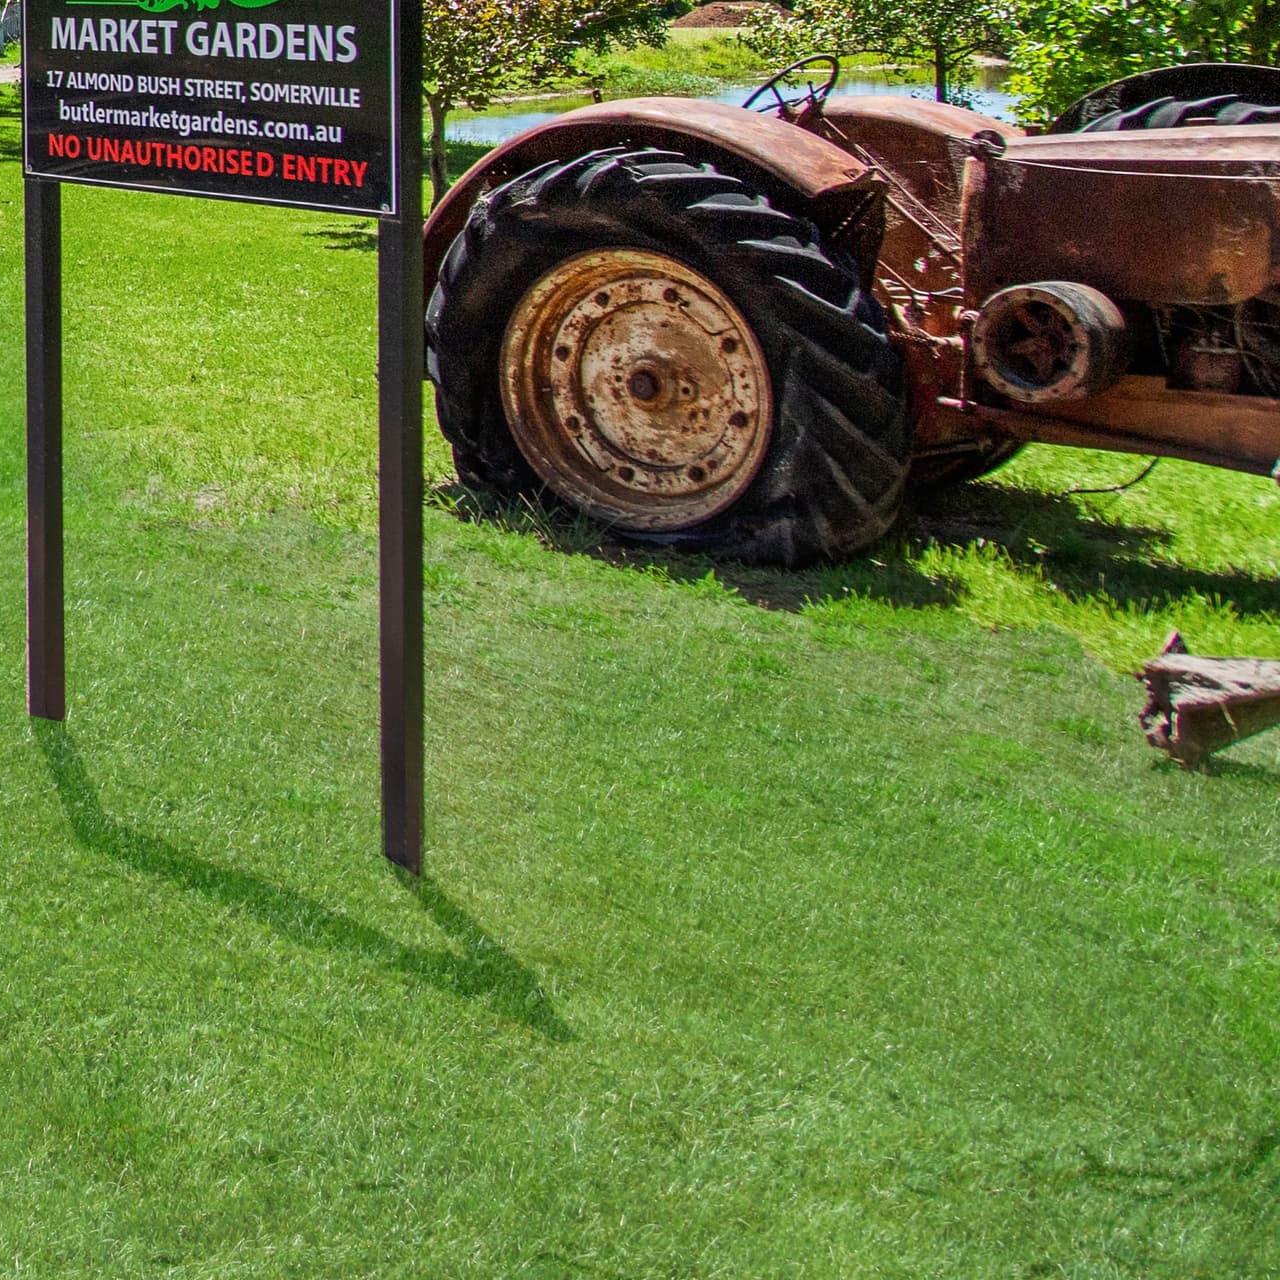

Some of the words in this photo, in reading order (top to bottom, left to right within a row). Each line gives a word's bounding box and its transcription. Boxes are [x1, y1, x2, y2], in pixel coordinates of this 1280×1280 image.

[51, 17, 178, 55] MARKET
[186, 21, 358, 63] GARDENS
[46, 70, 64, 88] 17
[67, 72, 134, 93] ALMOND
[138, 76, 180, 97] BUSH
[184, 78, 246, 104] STREET,
[250, 82, 361, 108] SOMERVILLE
[59, 100, 343, 144] butlermarketgardens.com.au
[48, 133, 81, 158] NO
[86, 137, 275, 178] UNAUTHORISED
[282, 154, 368, 188] ENTRY
